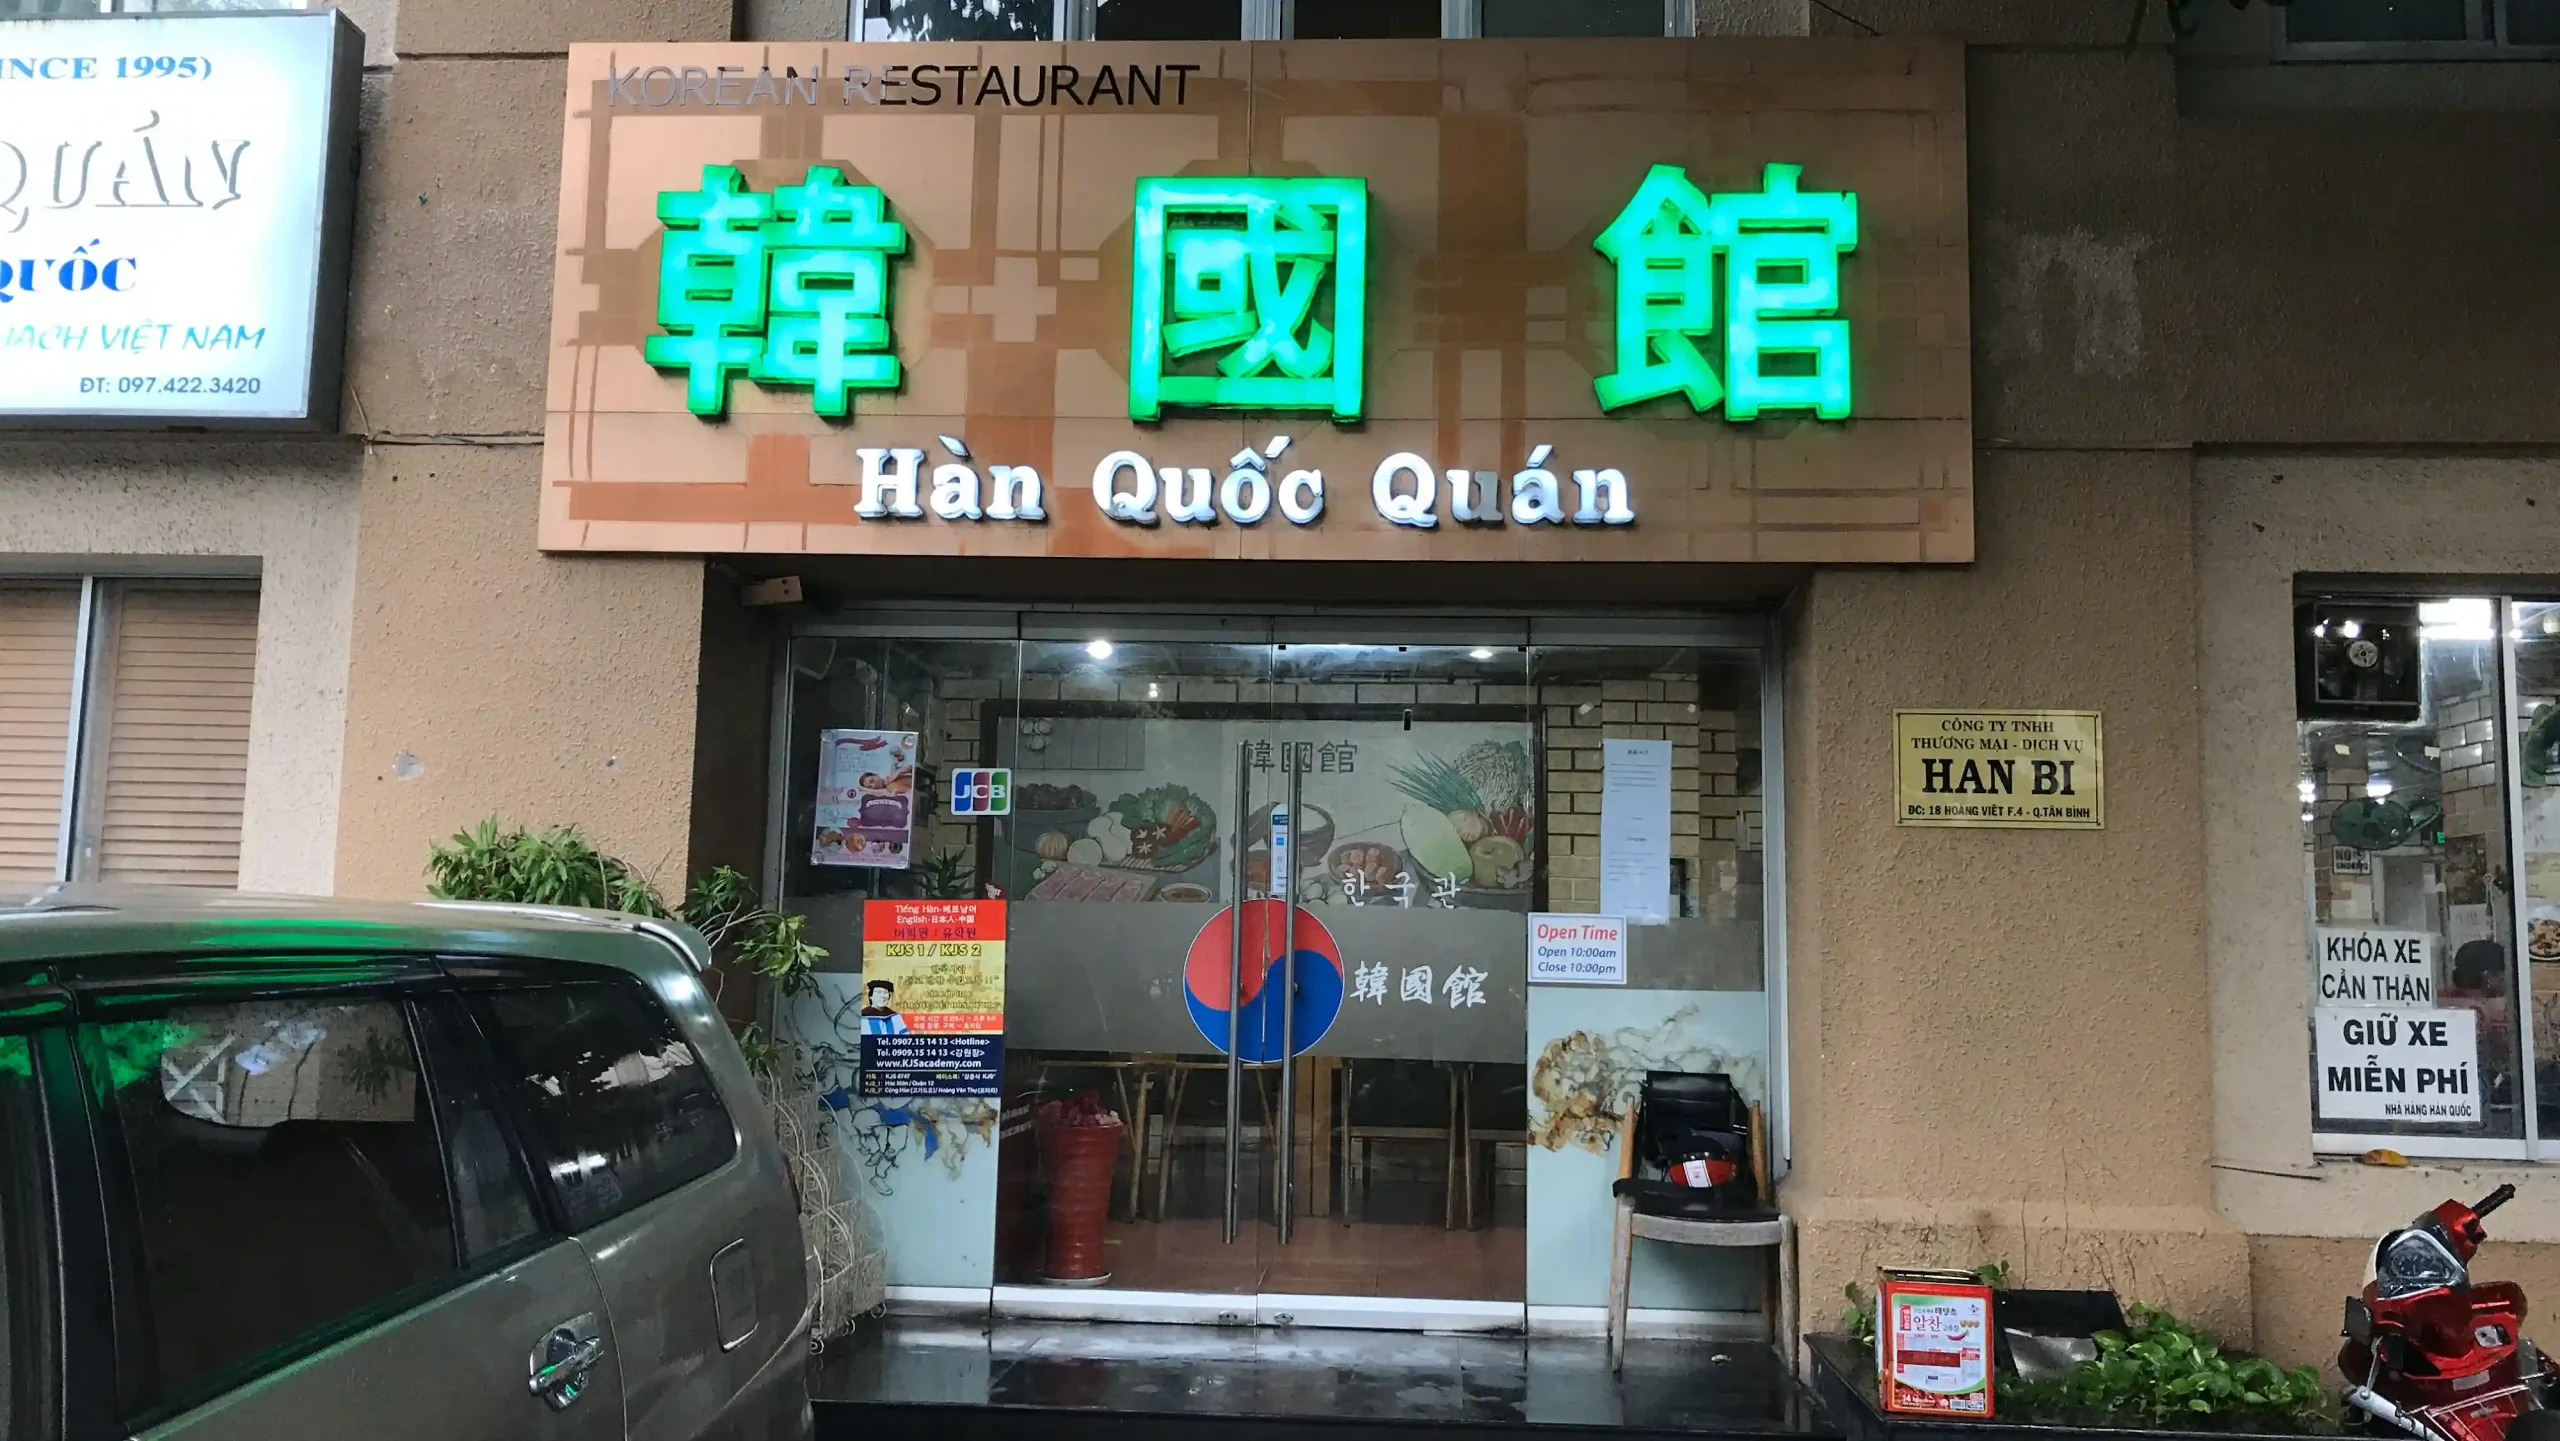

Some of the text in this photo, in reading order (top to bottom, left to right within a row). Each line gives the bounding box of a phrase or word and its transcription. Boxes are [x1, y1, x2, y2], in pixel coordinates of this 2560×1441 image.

[116, 56, 212, 81] 1995)
[606, 63, 1202, 107] KOREAN RESTAURANT
[101, 319, 173, 355] VIỆT
[182, 324, 266, 351] NAM
[80, 376, 261, 395] ĐT: 097.422.3420
[855, 434, 1636, 528] Hàn Quốc Quán
[1941, 717, 2054, 733] CÔNG TY TNHH
[1911, 736, 1975, 750] THƯƠNG
[1979, 738, 2008, 753] MẠI
[2022, 739, 2058, 753] DỊCH
[2063, 739, 2084, 753] VỤ
[1921, 758, 2075, 795] HAN BI
[954, 784, 1006, 799] JCB
[1908, 804, 1925, 815] ĐC:
[1929, 805, 1941, 815] 18
[2007, 806, 2023, 816] F.4
[2033, 805, 2063, 818] Q.TÂN
[1341, 869, 1462, 909] 한국관
[1537, 924, 1618, 943] Open Time
[886, 943, 914, 957] KJS
[917, 944, 925, 957] 1
[940, 943, 968, 957] KJS
[971, 943, 982, 957] 2
[1538, 947, 1616, 961] Open 10:00am
[2326, 932, 2421, 963] KHÓA XE
[1538, 961, 1616, 975] Close 10:00pm
[1349, 960, 1488, 1009] 韓國館
[2372, 974, 2430, 1006] THẬN
[2343, 1012, 2448, 1046] GIỮ XE
[877, 1037, 990, 1046] Tel. 0907.15 14 13 <Hotline>
[877, 1048, 891, 1057] Tel.
[892, 1048, 925, 1057] 0909.15
[927, 1049, 936, 1057] 14
[939, 1049, 948, 1057] 13
[876, 1059, 981, 1069] www.KJSacademy.com
[2327, 1054, 2468, 1094] MIỄN PHÍ
[2385, 1100, 2402, 1115] NHÀ
[2404, 1100, 2427, 1116] HÀNG
